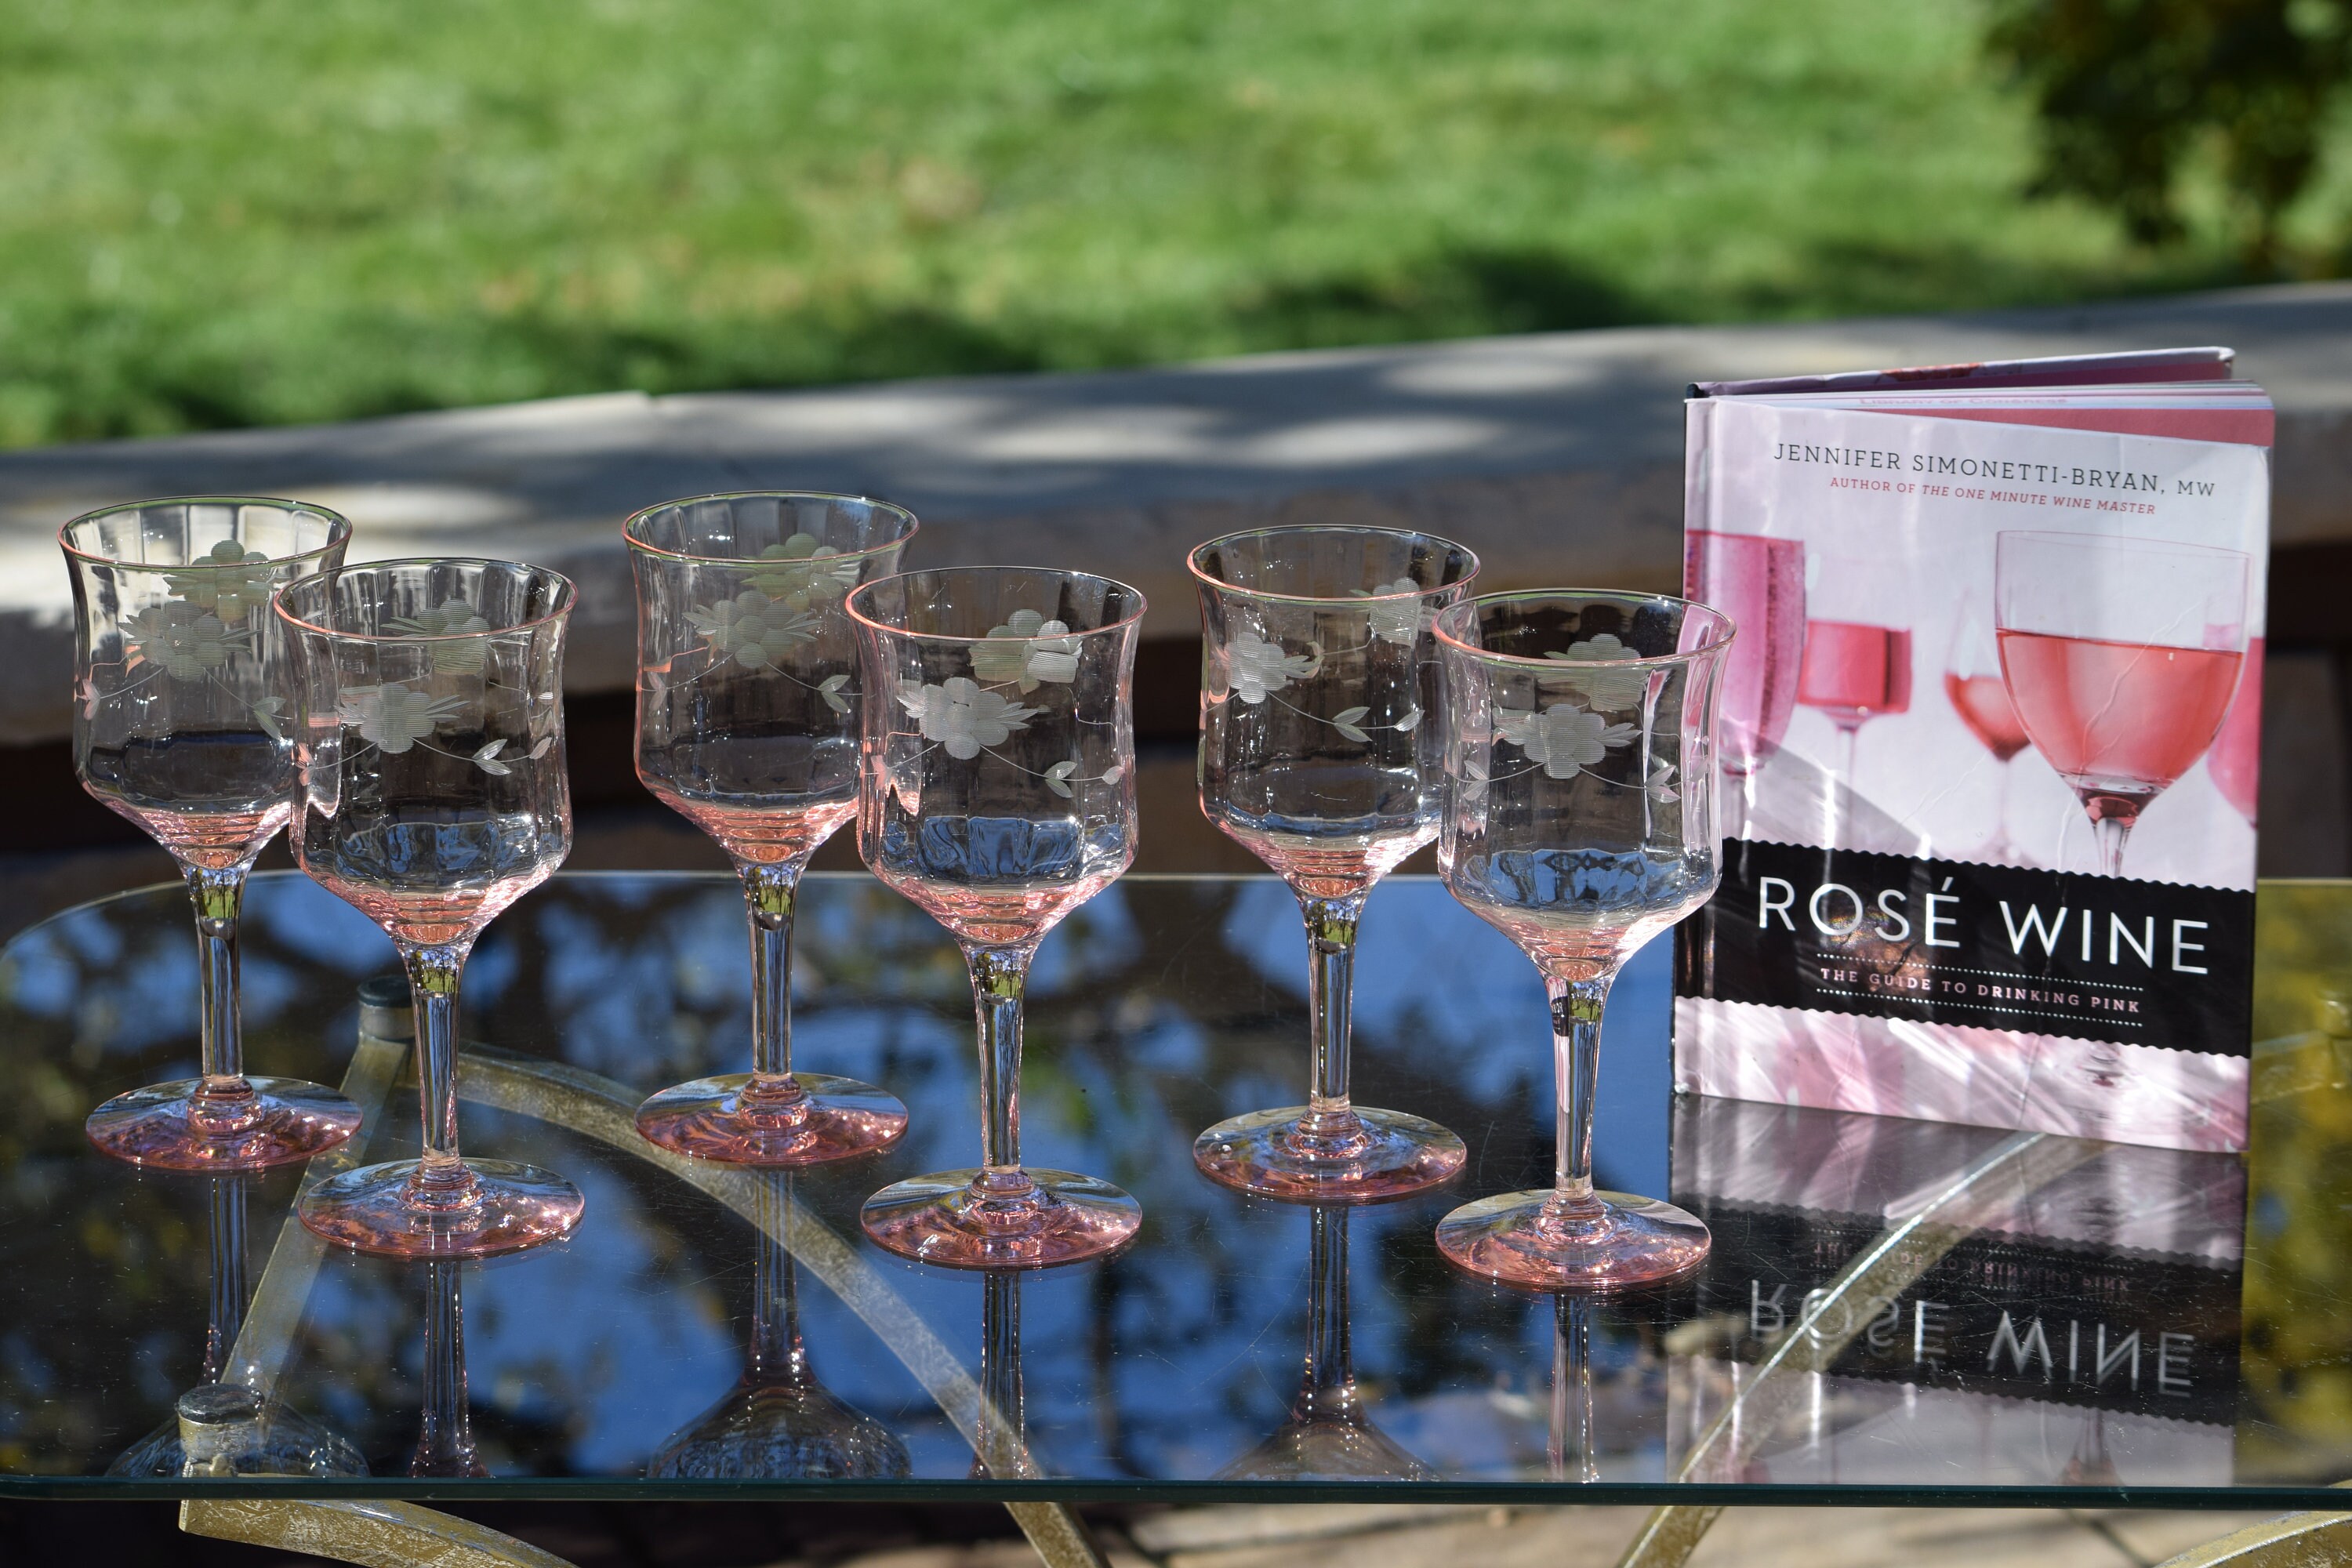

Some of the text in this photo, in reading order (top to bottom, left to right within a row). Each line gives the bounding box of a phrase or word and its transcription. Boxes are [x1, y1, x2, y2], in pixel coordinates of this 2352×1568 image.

[1774, 443, 2216, 497] JENNIFER SIMONETTI-BRYAN, MW
[1829, 477, 2156, 515] AUTHOR OF THE ONE MINUTE WINE MASTER
[1759, 877, 2209, 975] ROSÉ WINE
[1820, 967, 2140, 1013] THE GUIDE TO DRINKING PINK
